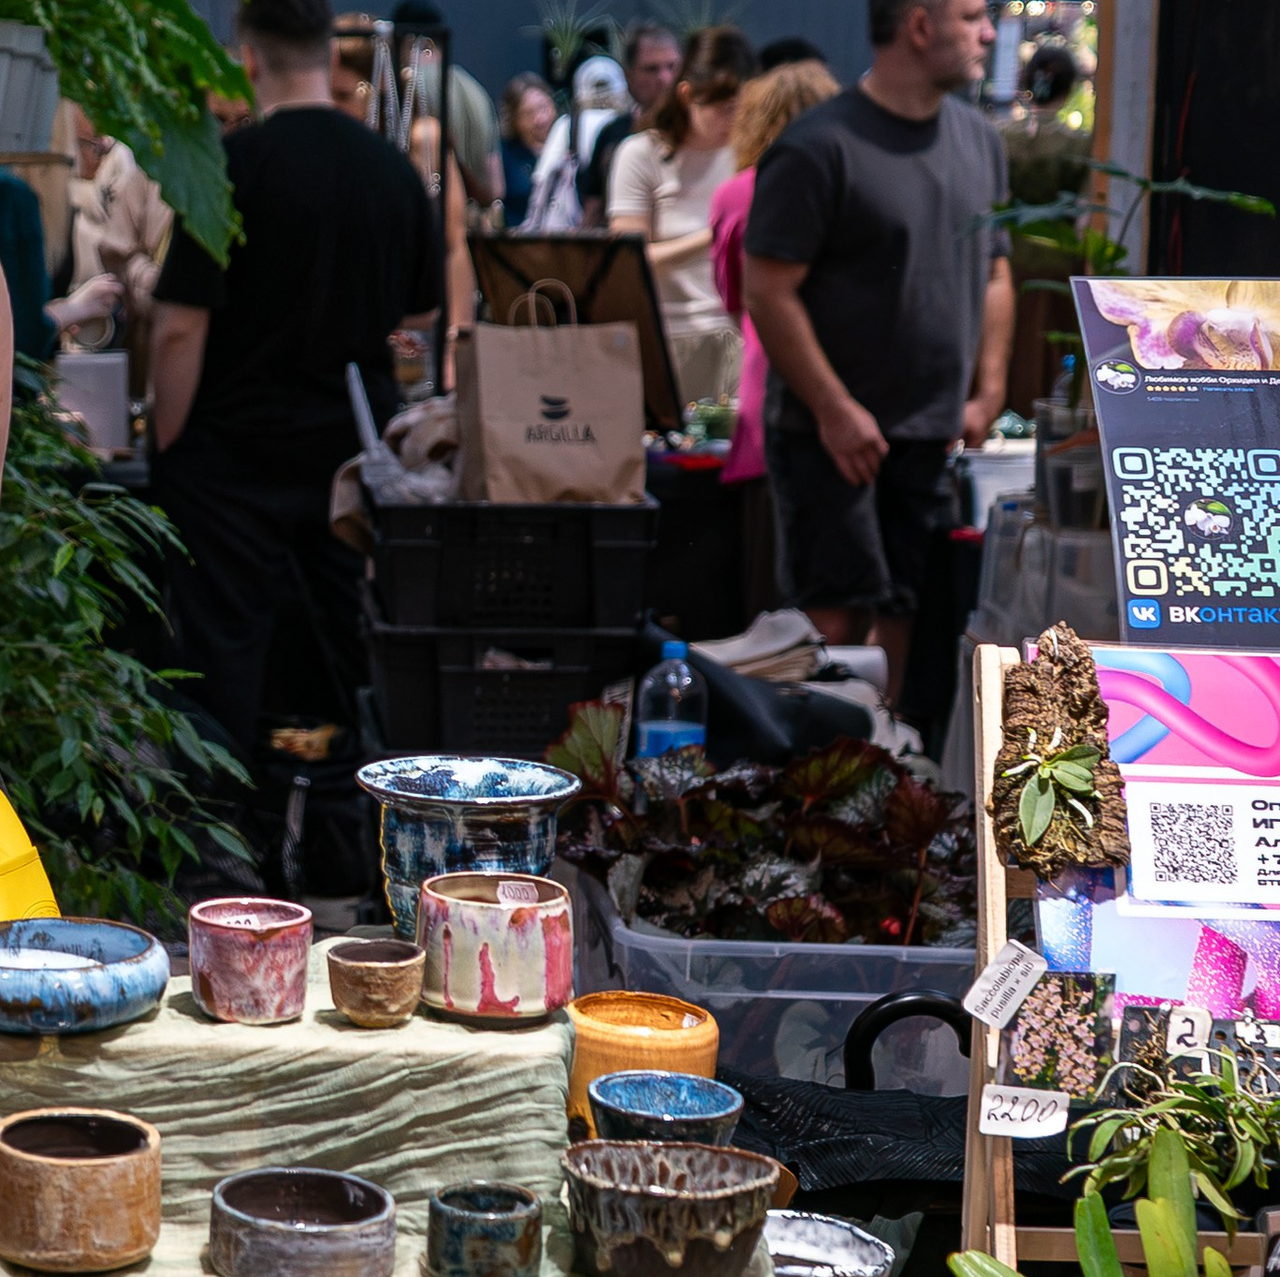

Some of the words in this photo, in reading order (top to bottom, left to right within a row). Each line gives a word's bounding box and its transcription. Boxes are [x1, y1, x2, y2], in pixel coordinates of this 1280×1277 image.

[525, 424, 597, 442] ARGILLA
[990, 986, 1017, 1020] pusilla
[987, 1094, 1059, 1123] 2200
